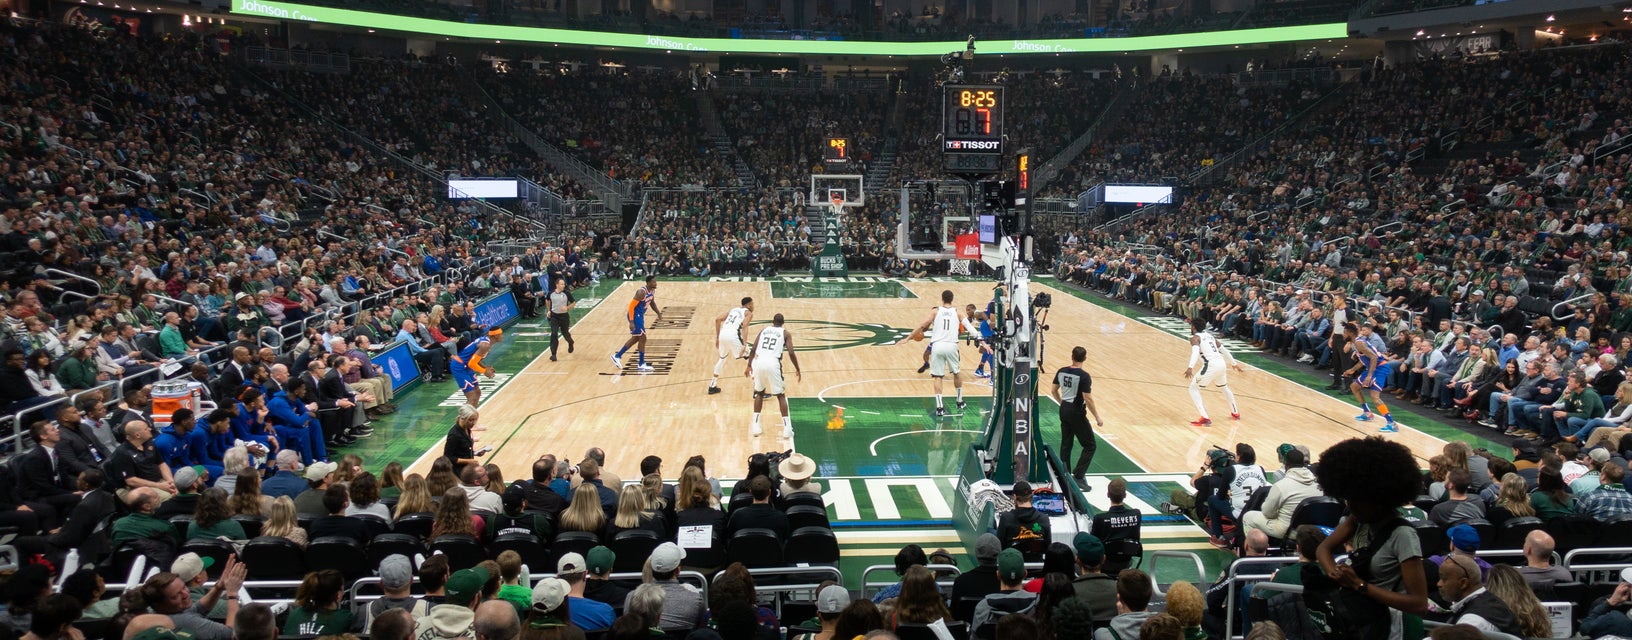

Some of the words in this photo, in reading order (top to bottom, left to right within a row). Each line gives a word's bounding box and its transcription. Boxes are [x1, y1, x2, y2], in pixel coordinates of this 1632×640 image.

[240, 0, 288, 18] Johnson
[646, 35, 683, 49] Johnson
[1012, 40, 1051, 52] Johnson
[1467, 36, 1491, 49] FEAR
[961, 91, 995, 107] 8:25
[976, 108, 990, 134] 7
[961, 141, 1000, 149] TISSOT
[943, 318, 950, 330] 11
[762, 336, 777, 351] 22
[1063, 375, 1072, 388] 56
[1014, 397, 1028, 456] NBA
[1110, 515, 1138, 525] MEYER'S
